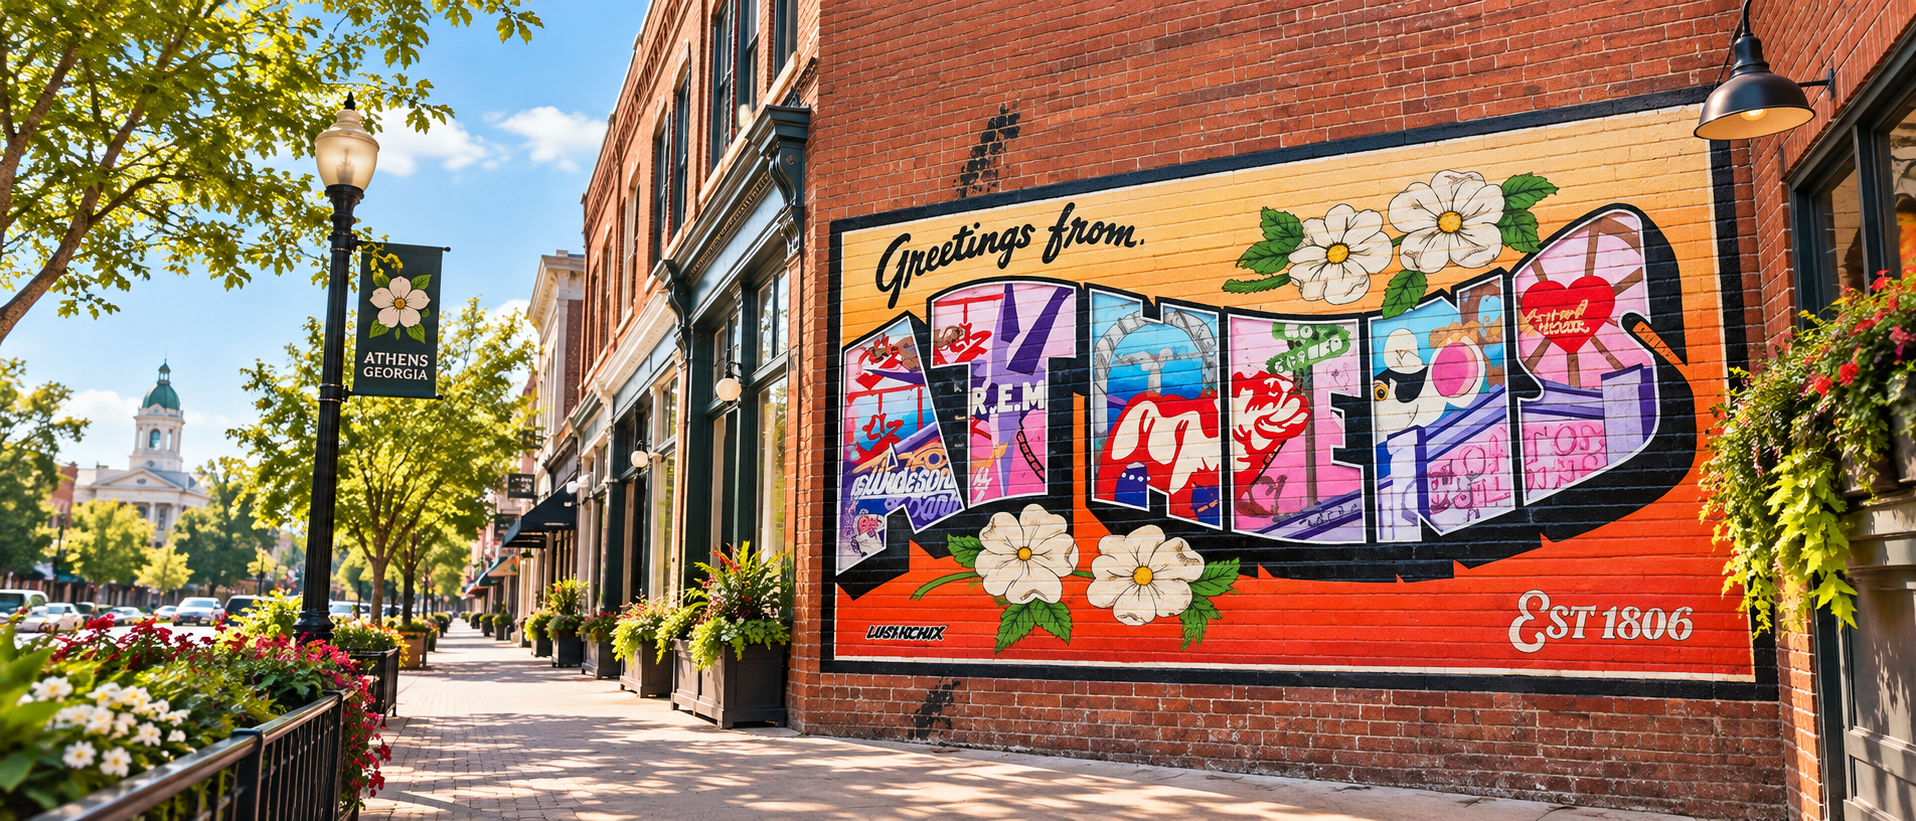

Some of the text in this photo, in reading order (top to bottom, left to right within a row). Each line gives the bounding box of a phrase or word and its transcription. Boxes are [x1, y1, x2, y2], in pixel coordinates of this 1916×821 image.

[875, 222, 1036, 310] Greetings
[363, 351, 429, 367] ATHENS
[363, 366, 429, 381] GEORGIA
[835, 206, 1664, 577] ATHENS
[1601, 606, 1694, 641] 1806
